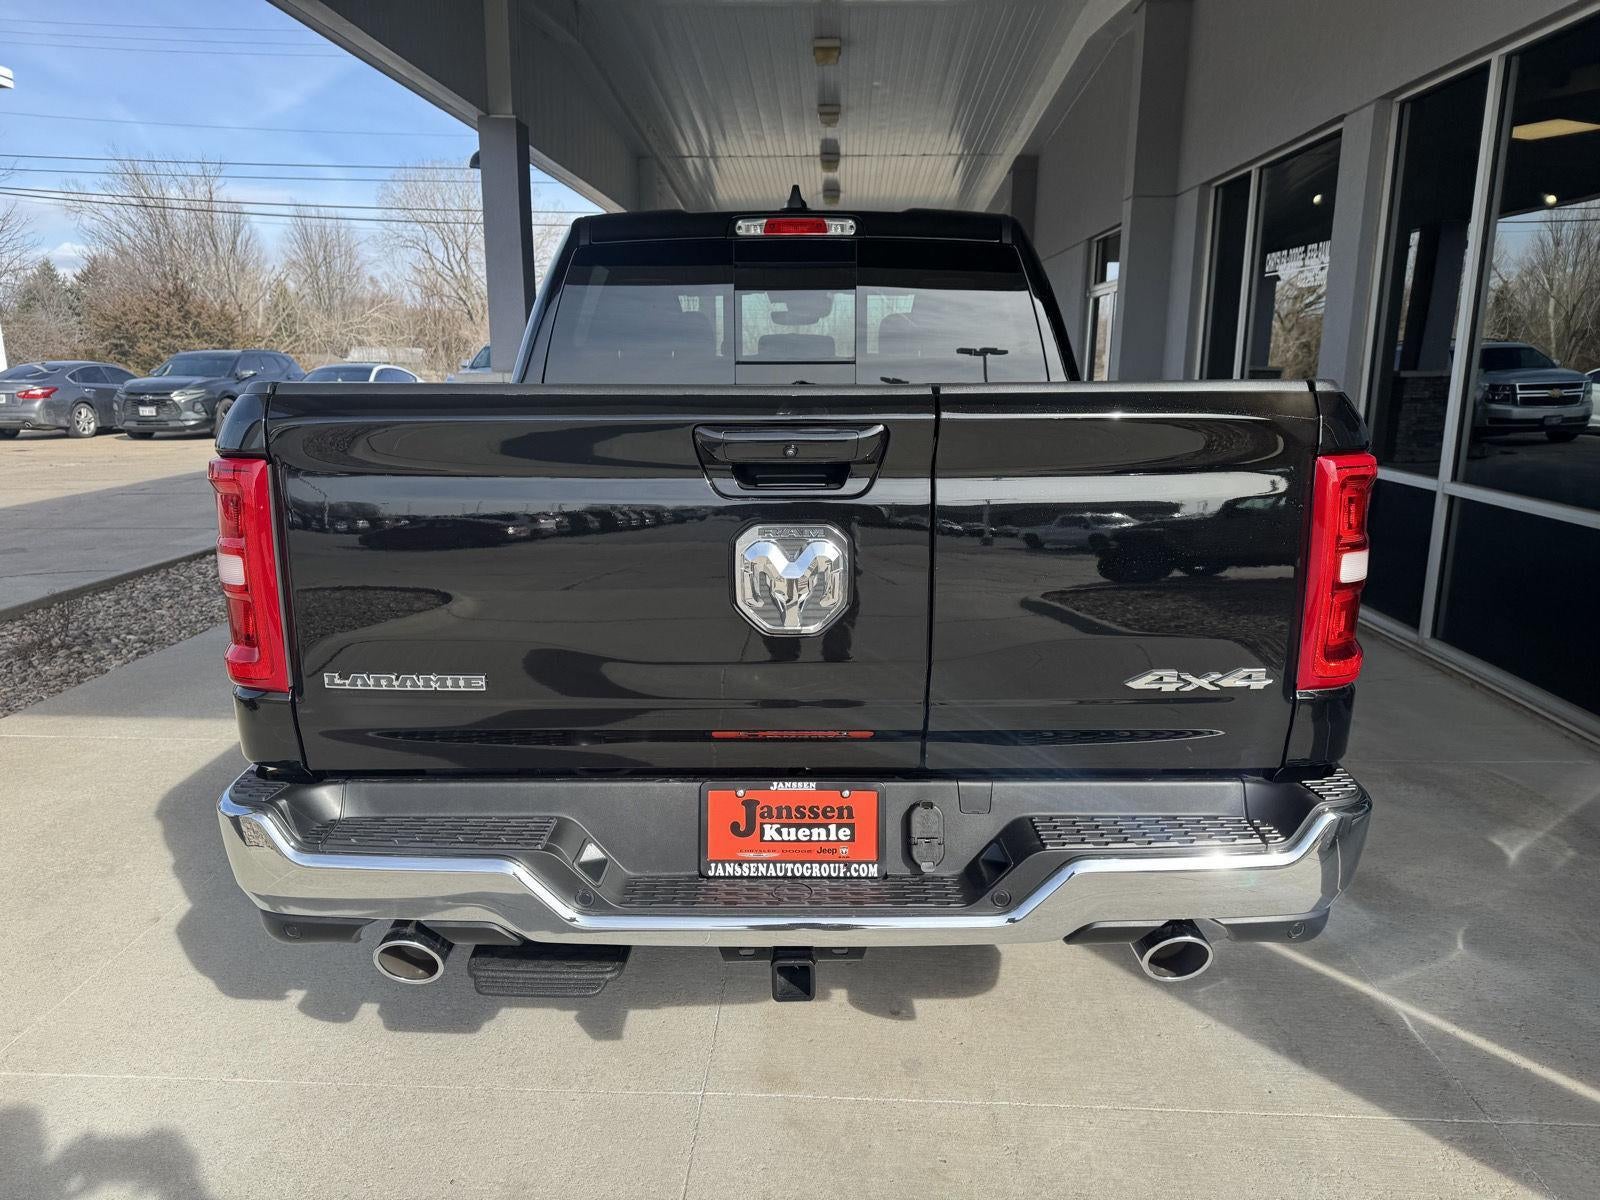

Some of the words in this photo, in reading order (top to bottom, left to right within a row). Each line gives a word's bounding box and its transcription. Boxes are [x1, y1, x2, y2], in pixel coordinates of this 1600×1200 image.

[758, 527, 826, 538] RAM
[323, 672, 487, 691] LARAMIE
[770, 781, 817, 791] JANSSEN
[730, 799, 855, 838] Janssen
[762, 824, 851, 841] Kuenle
[816, 846, 838, 855] Jeep
[707, 862, 879, 877] JANSSENAUTOGROUP.COM
